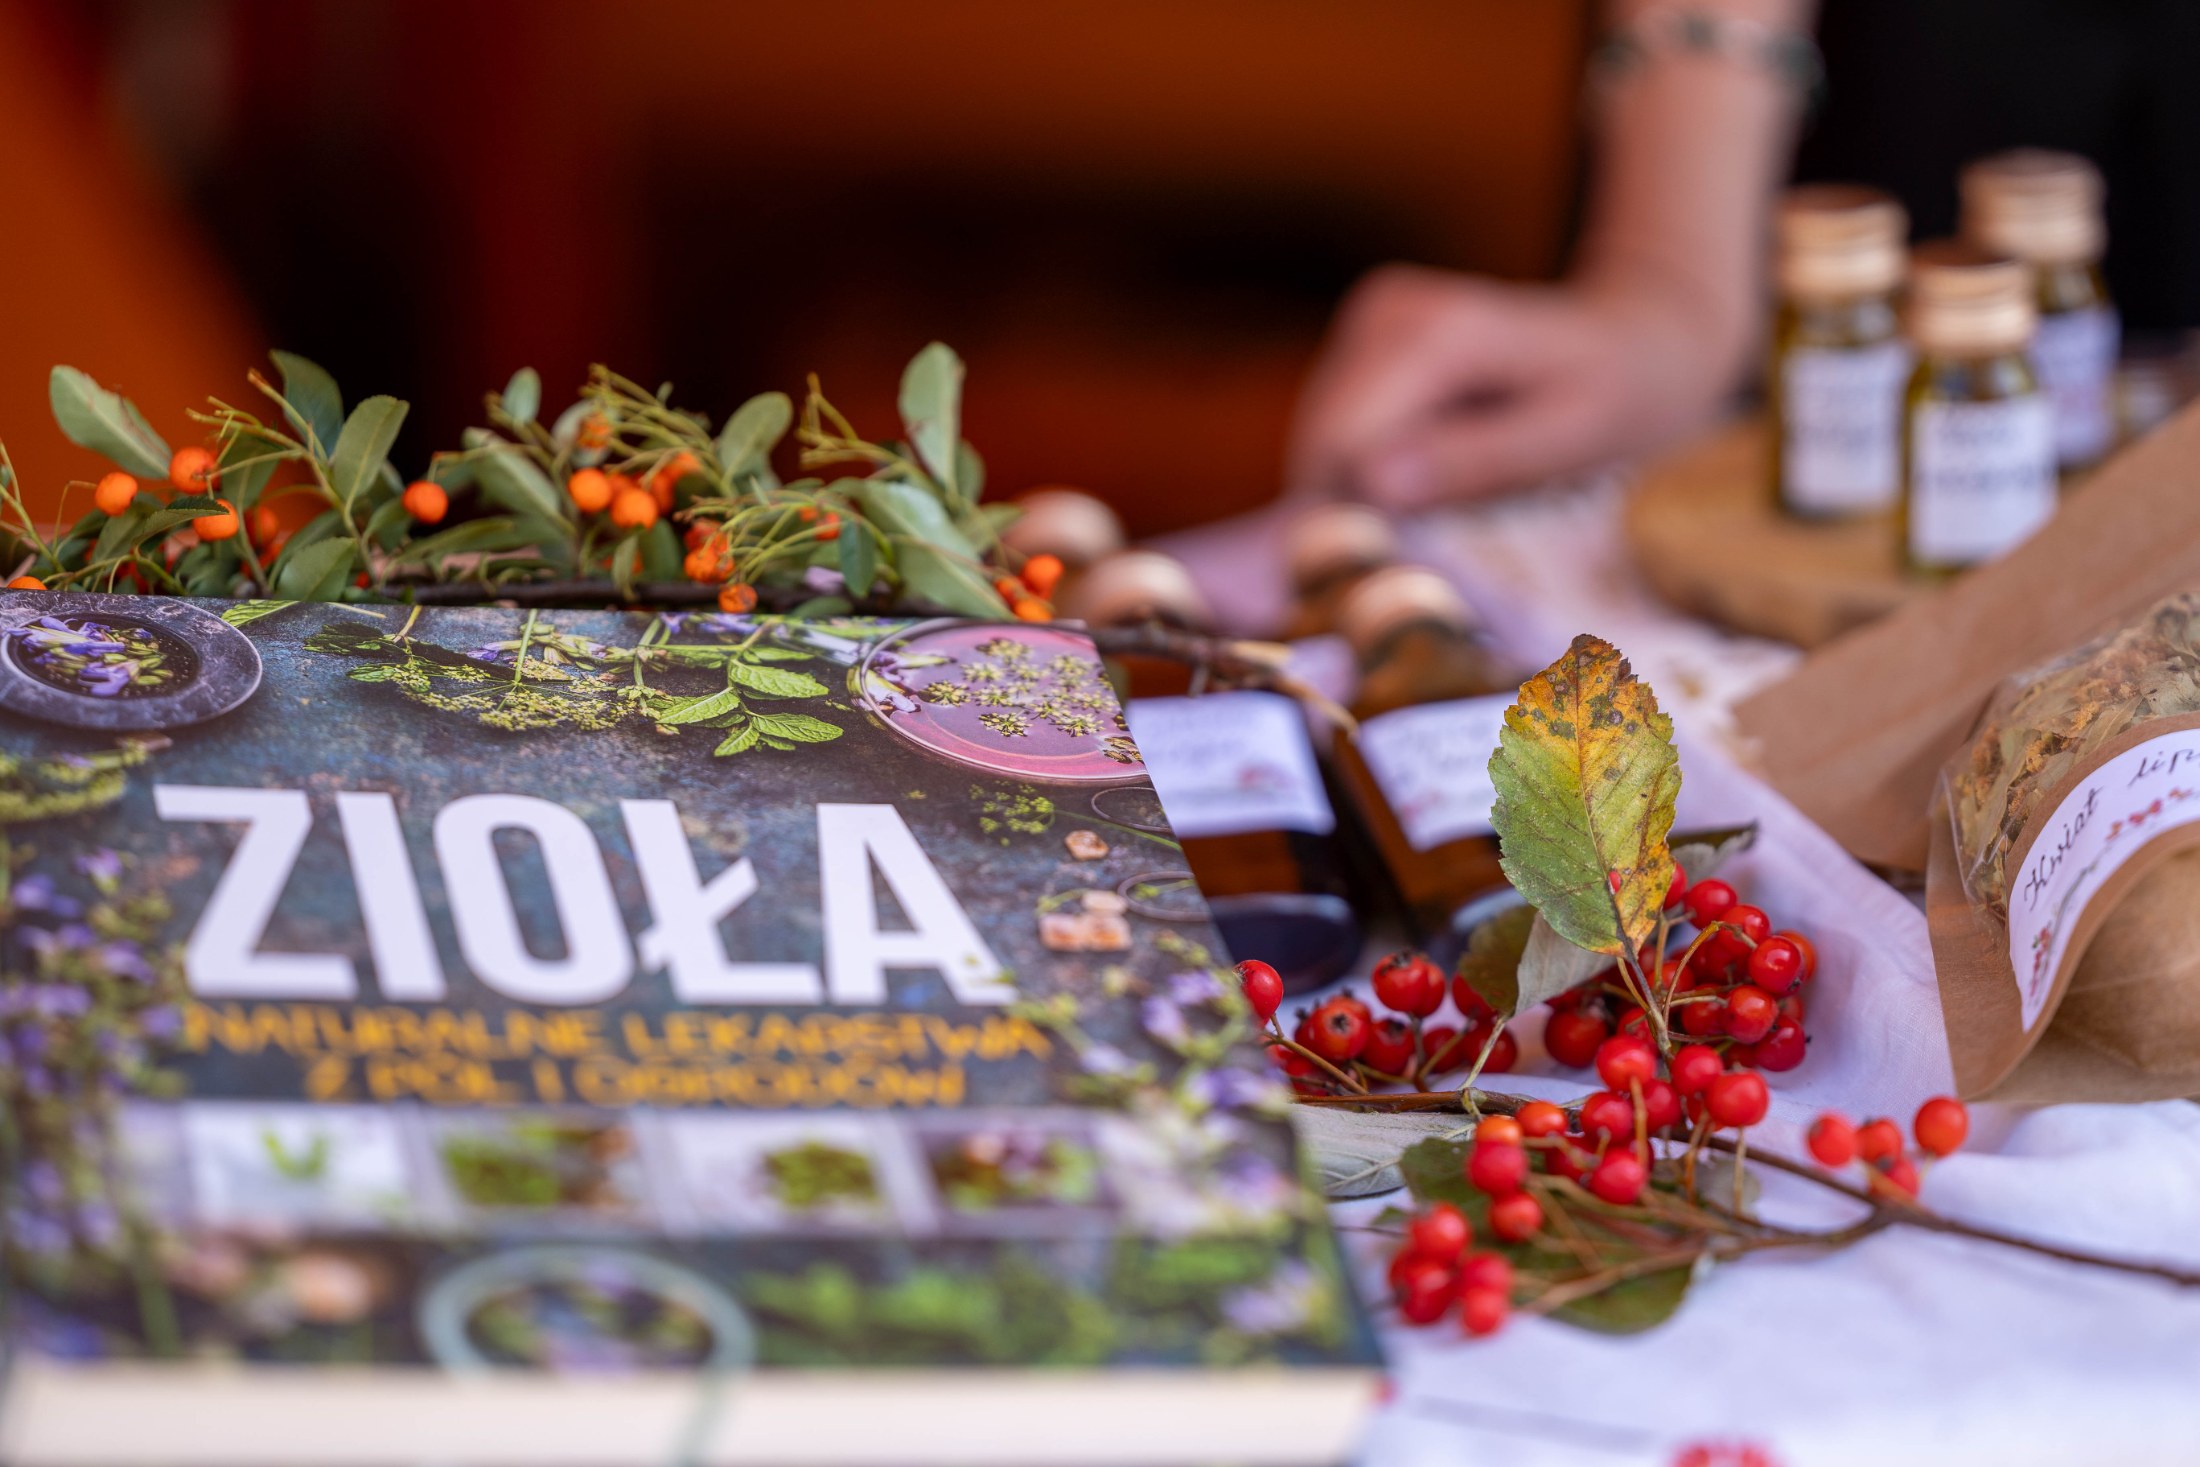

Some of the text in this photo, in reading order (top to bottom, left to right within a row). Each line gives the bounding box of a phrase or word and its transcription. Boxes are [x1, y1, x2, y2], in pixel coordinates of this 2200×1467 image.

[2127, 748, 2200, 789] lip
[154, 784, 1018, 1004] ZIOŁA
[184, 1001, 1052, 1064] NATURALNE LEKARSTWA
[531, 1056, 566, 1105] I
